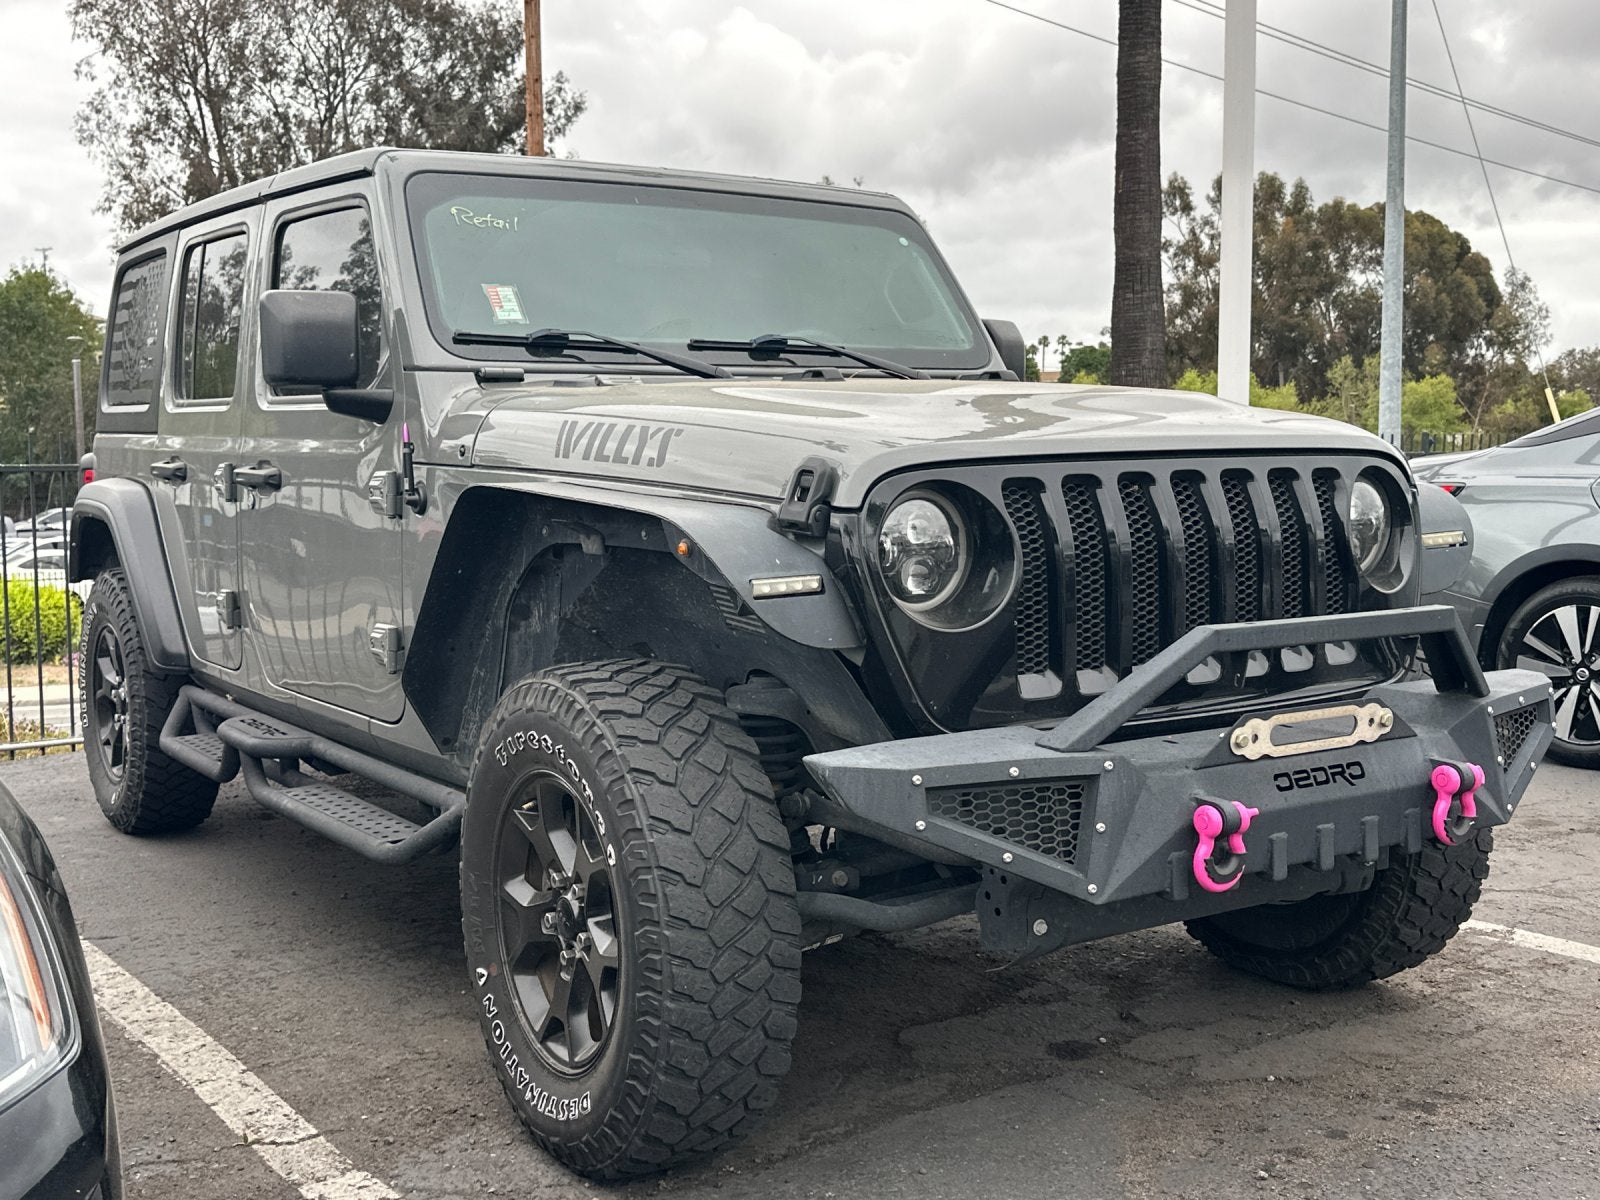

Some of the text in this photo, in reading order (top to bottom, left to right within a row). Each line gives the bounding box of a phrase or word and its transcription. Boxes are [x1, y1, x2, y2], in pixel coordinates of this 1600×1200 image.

[450, 206, 518, 231] Retail
[554, 419, 684, 468] WILLYS
[483, 993, 591, 1120] DESTINATION
